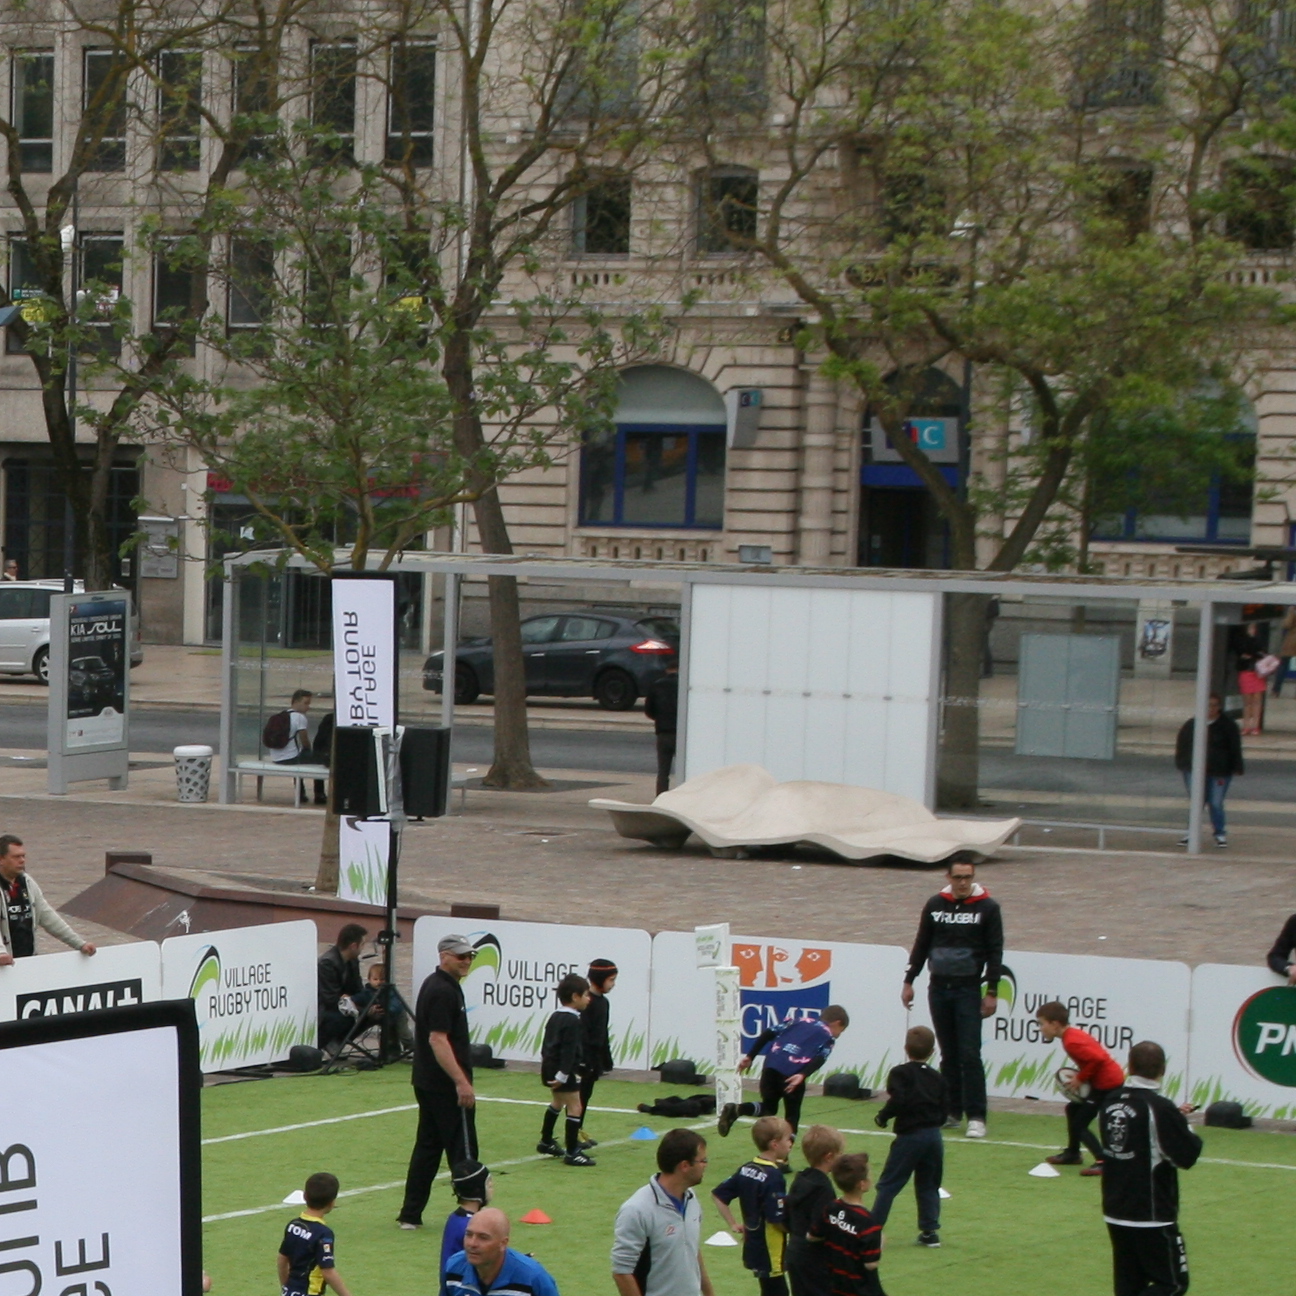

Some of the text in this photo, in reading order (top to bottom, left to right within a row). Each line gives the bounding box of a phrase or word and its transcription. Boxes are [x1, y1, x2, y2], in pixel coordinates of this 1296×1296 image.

[70, 621, 122, 636] KIA SOUL
[225, 963, 271, 988] VILLAGE
[507, 959, 579, 983] VILLAGE
[209, 986, 288, 1019] RUGBY TOUR
[483, 983, 546, 1008] RUGBY
[288, 1223, 313, 1241] TOM
